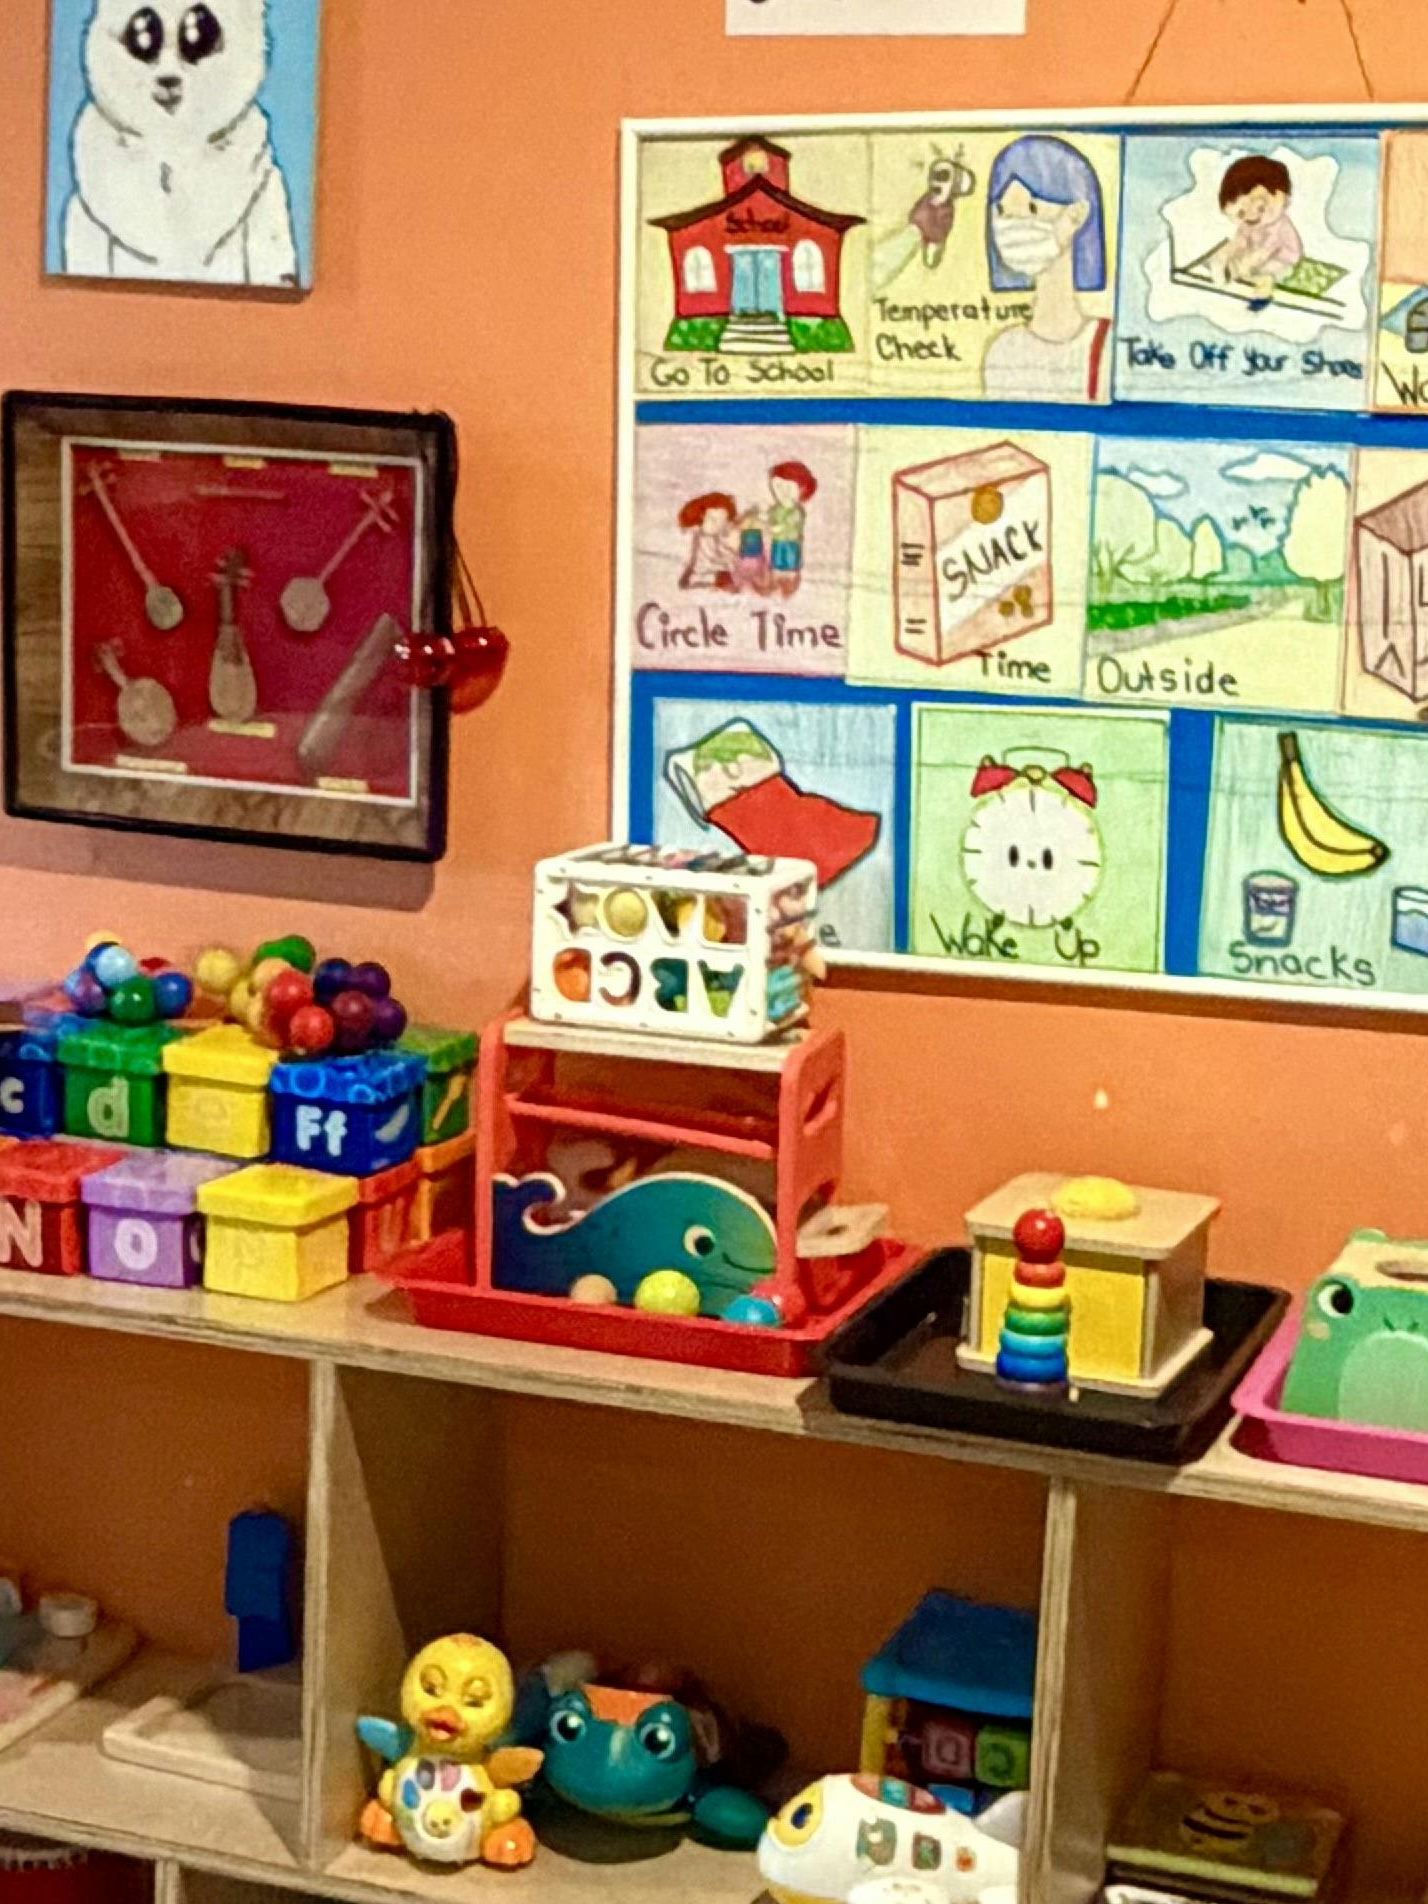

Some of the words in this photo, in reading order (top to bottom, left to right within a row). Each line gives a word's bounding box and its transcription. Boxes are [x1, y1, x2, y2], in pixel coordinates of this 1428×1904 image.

[873, 296, 1034, 332] Temperature
[875, 334, 962, 363] Check
[1120, 337, 1177, 369] Take
[1190, 341, 1233, 371] Off
[650, 359, 691, 387] Go
[699, 358, 731, 387] To
[746, 357, 834, 385] School
[940, 519, 1044, 600] SNACK
[636, 602, 729, 652] Circle
[751, 609, 842, 650] Time
[977, 649, 1052, 685] Time
[1096, 658, 1240, 698] Outside
[929, 914, 1018, 961] Wake
[1053, 918, 1102, 967] Up
[1229, 940, 1376, 986] Snacks
[88, 1079, 129, 1135] d
[295, 1107, 347, 1156] Ff
